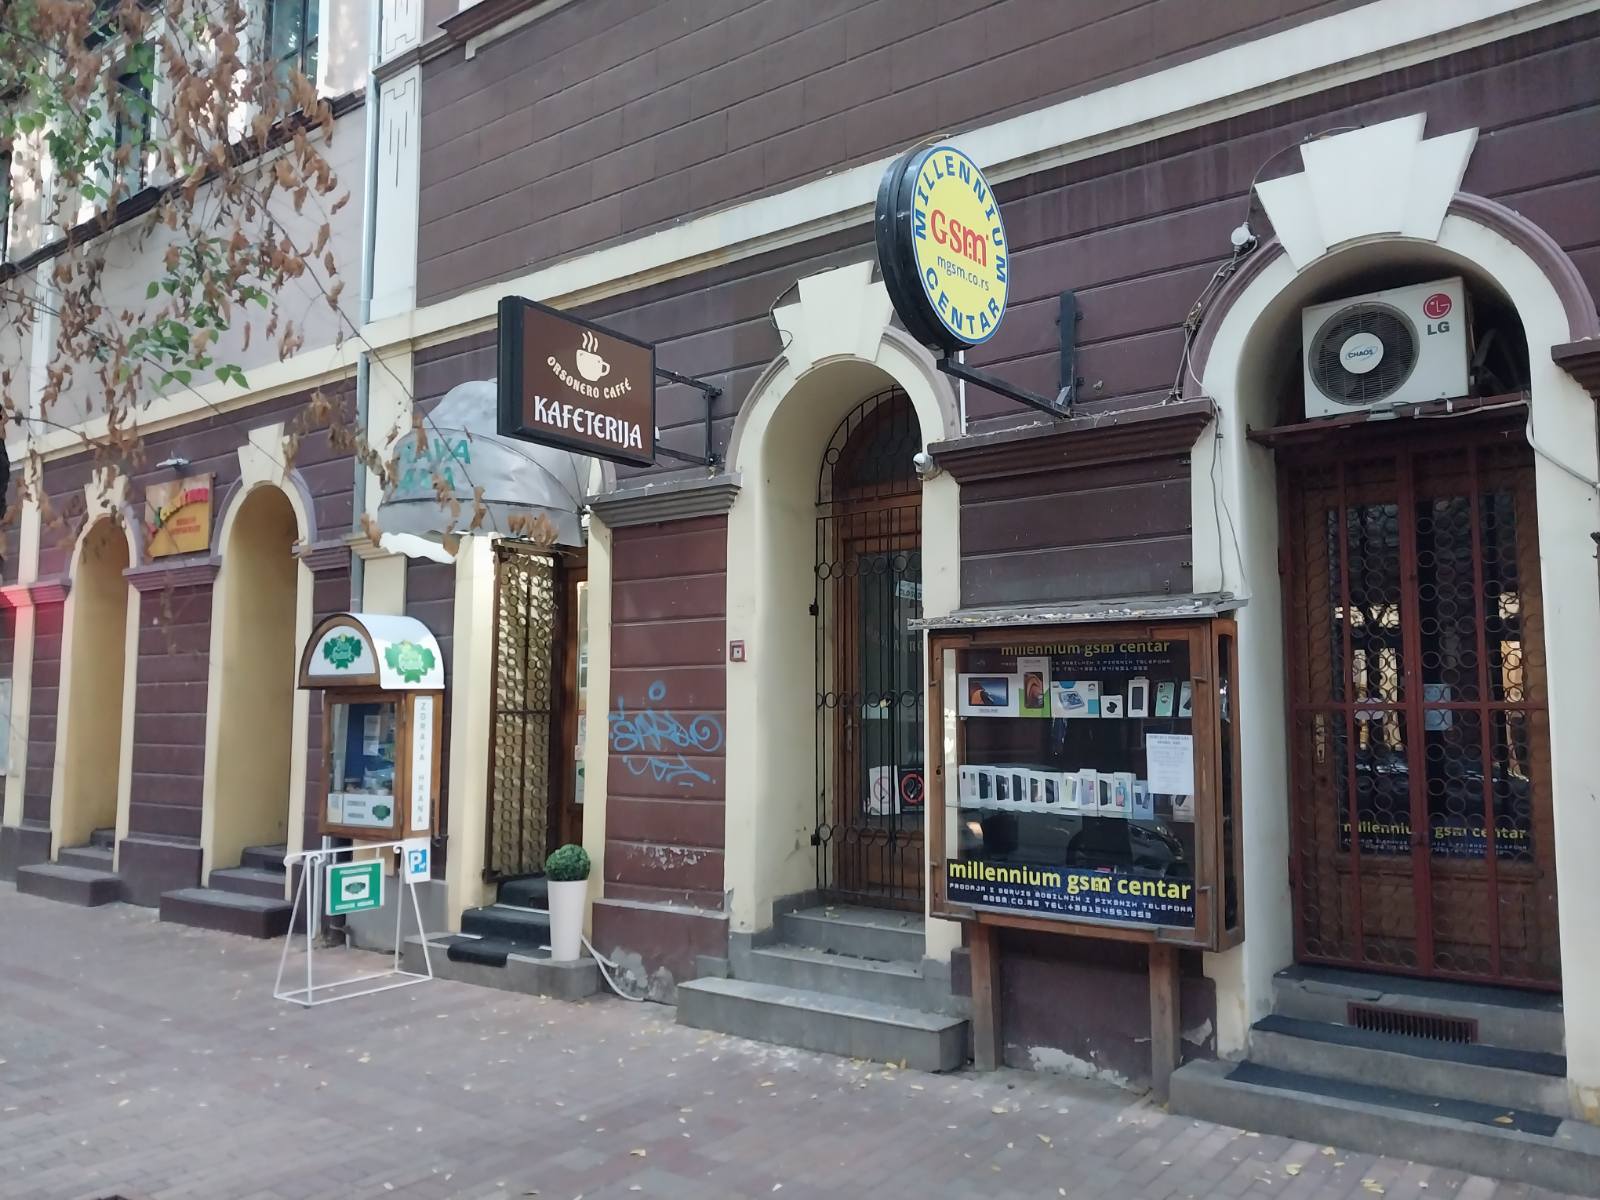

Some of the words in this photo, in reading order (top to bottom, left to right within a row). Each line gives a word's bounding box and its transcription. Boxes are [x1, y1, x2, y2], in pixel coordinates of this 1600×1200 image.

[915, 155, 1006, 283] MILLENNIUM
[937, 255, 990, 291] mgsm.co.rs
[925, 267, 1000, 335] CENTAR
[1427, 321, 1450, 336] LG
[1348, 349, 1373, 358] CHAOS
[547, 356, 600, 399] ORSONERO
[534, 395, 643, 449] KAFETERIJA
[1085, 642, 1115, 657] gsm
[1120, 640, 1170, 654] centar
[949, 861, 1061, 887] millennium
[1067, 875, 1112, 895] gsm
[1117, 878, 1192, 900] centar
